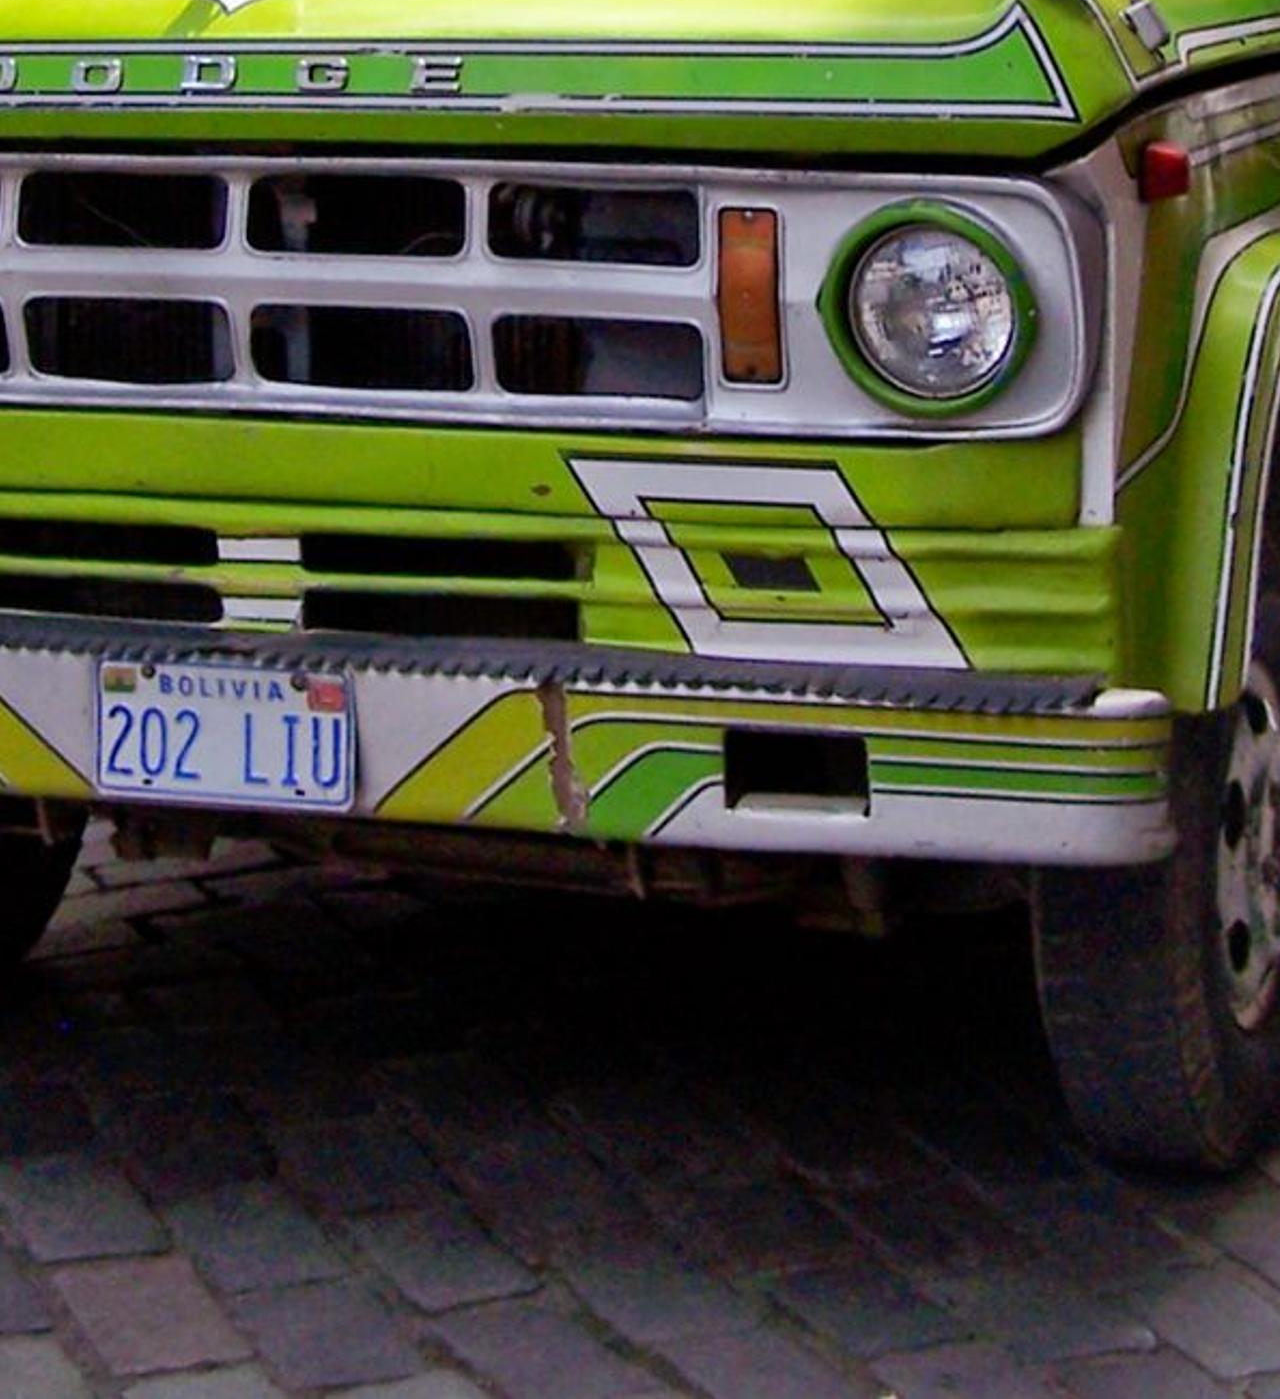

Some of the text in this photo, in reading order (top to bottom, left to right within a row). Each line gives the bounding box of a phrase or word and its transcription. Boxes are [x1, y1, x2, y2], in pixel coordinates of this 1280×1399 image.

[158, 673, 285, 700] BOLIVIA
[106, 703, 342, 788] 202 LIU
